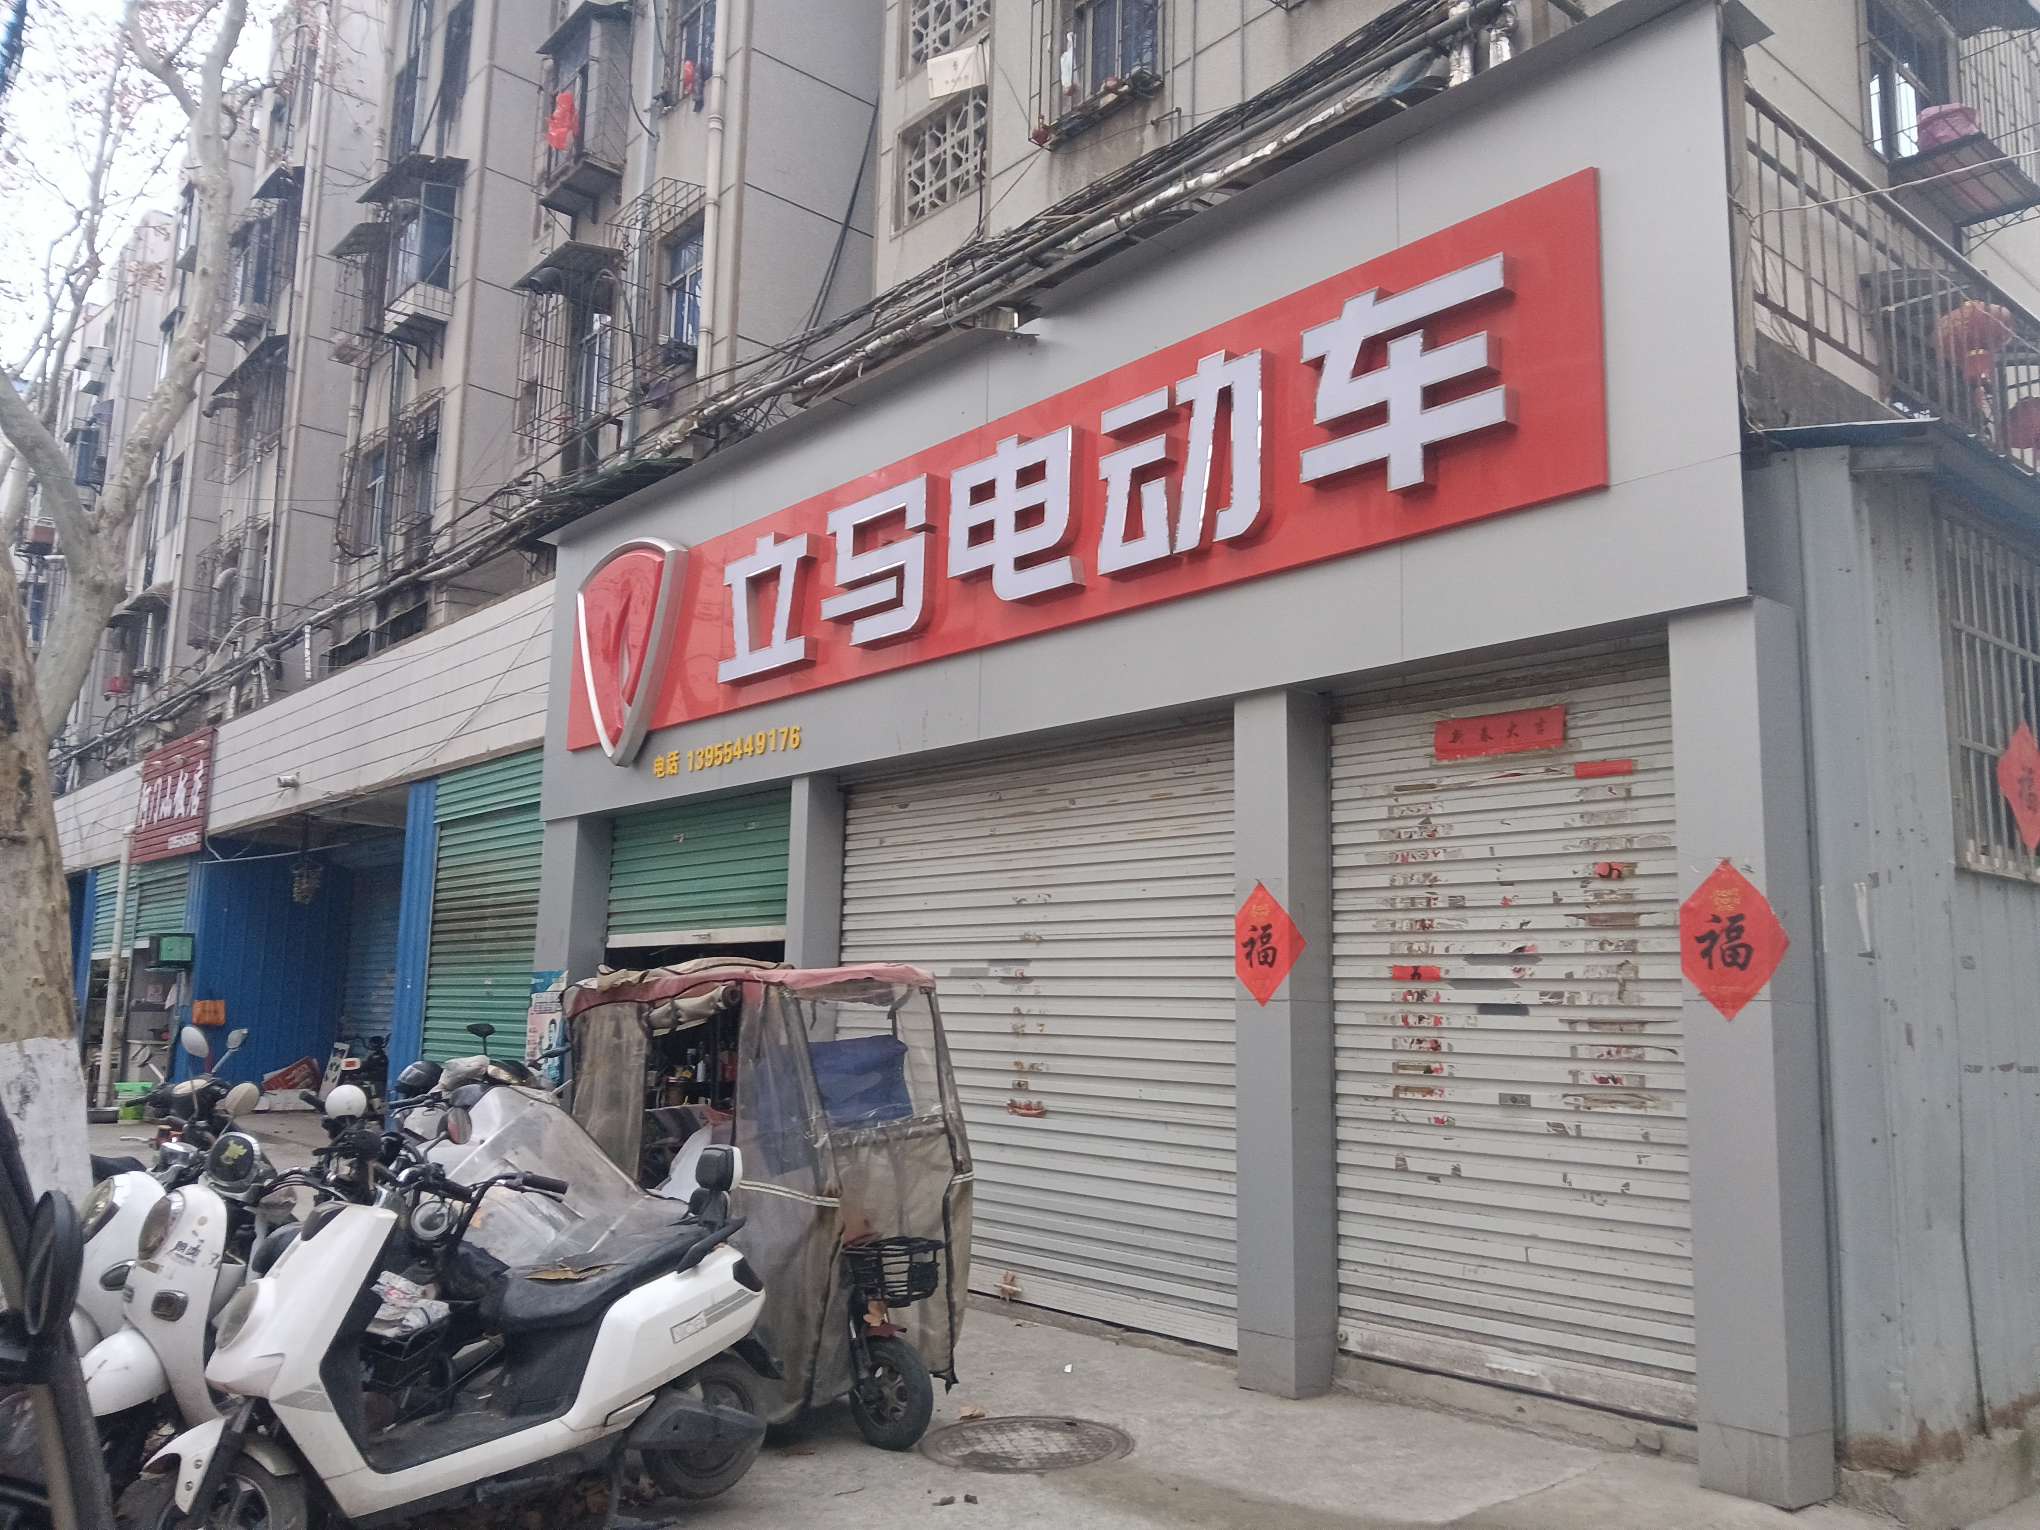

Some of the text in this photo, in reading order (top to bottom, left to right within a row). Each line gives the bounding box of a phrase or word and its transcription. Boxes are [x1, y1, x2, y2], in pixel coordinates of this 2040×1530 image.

[717, 251, 1513, 685] 立马电动车
[654, 726, 801, 778] 电话 13955449176
[1241, 923, 1278, 969] 福
[1694, 914, 1755, 971] 福
